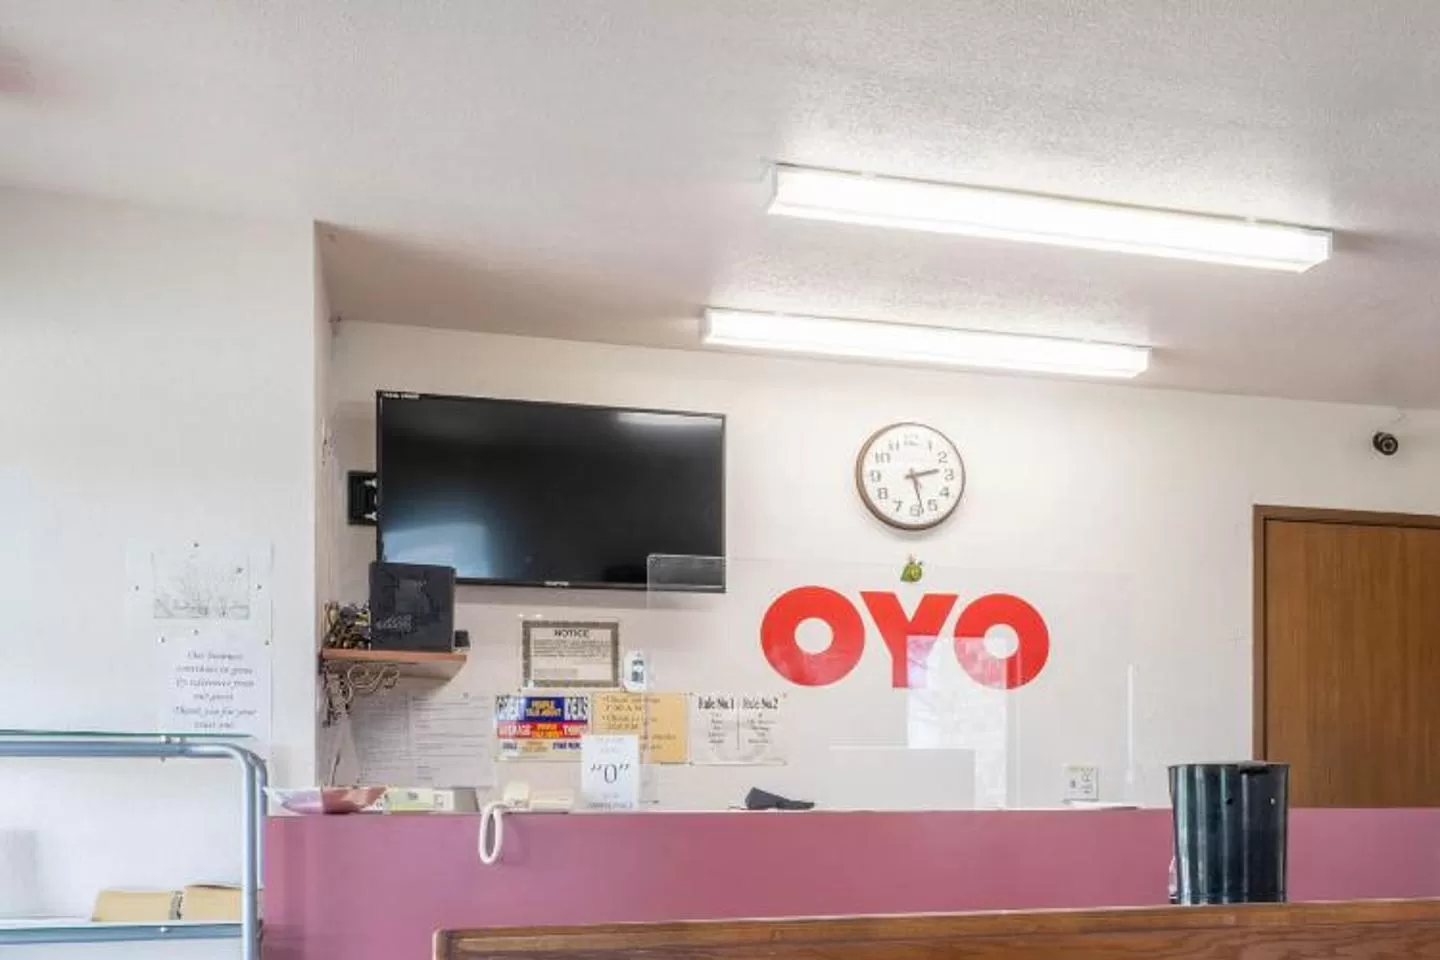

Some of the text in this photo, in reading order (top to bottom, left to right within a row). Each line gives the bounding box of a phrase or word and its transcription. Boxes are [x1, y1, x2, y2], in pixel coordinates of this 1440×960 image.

[937, 451, 948, 463] 2
[871, 469, 882, 482] 9
[944, 468, 955, 481] 3
[877, 487, 889, 500] 8
[939, 486, 950, 497] 4
[892, 499, 904, 512] 7
[553, 628, 590, 638] NOTICE
[760, 585, 1049, 690] OYO
